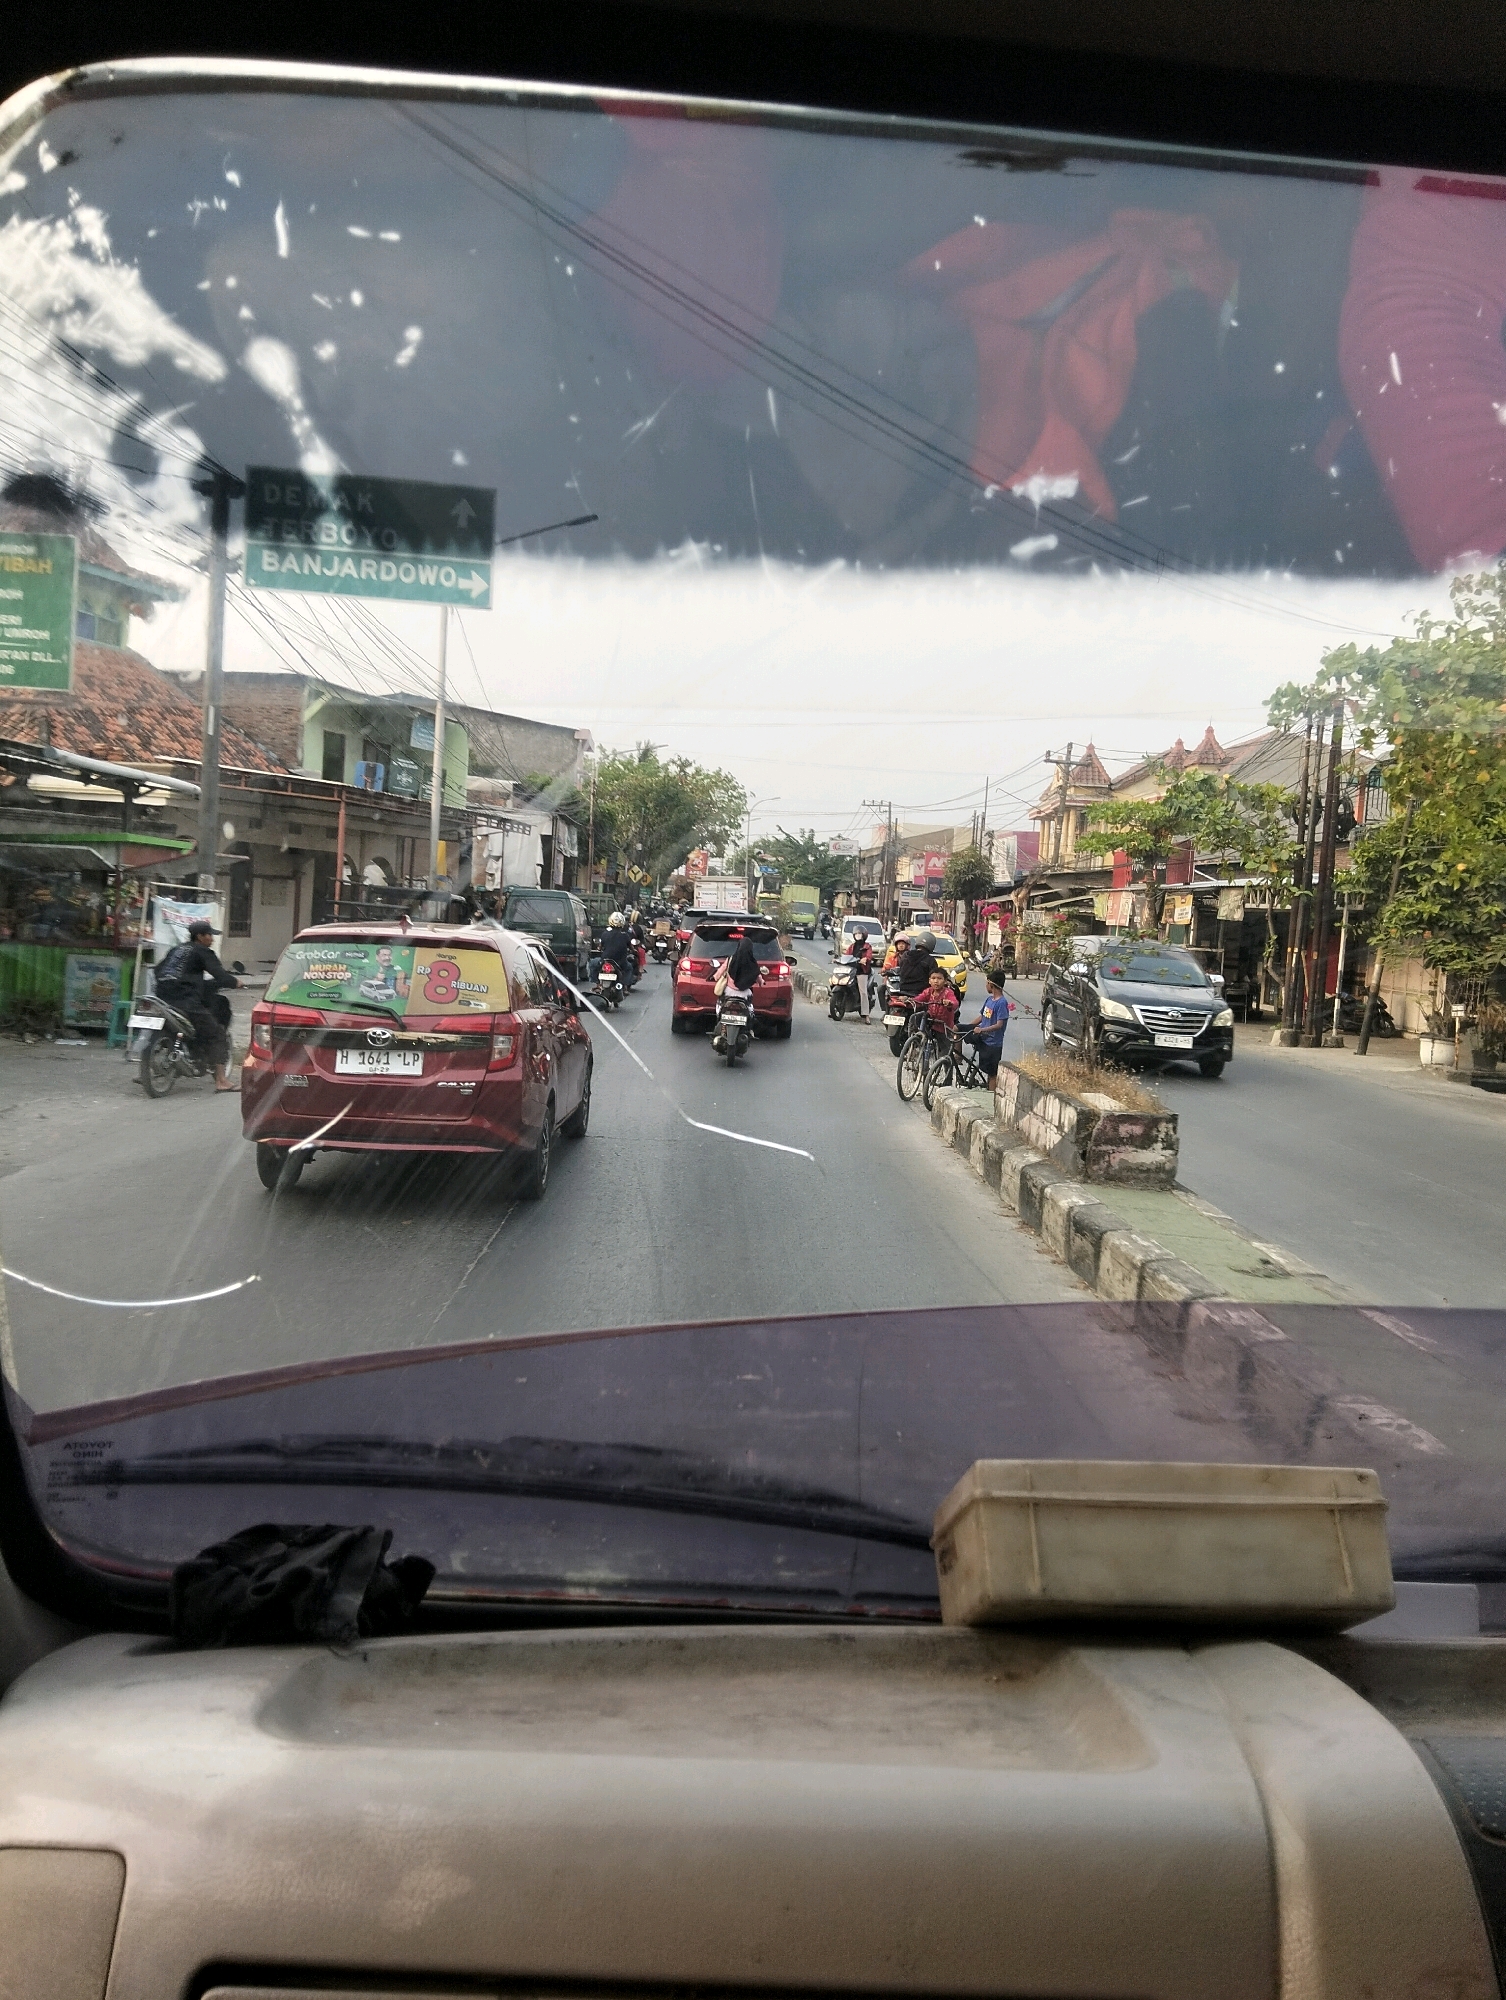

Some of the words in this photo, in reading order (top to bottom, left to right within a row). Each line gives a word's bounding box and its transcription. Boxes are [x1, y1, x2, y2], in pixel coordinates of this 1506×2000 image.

[263, 483, 374, 514] DEMAK
[261, 516, 398, 550] TERBOYO
[261, 549, 458, 588] BANJARDOWO
[295, 949, 340, 960] GrabCar
[310, 964, 347, 972] MURAH
[416, 965, 432, 976] Rp
[303, 971, 352, 981] NON-STOP
[423, 960, 461, 1005] 8
[450, 980, 489, 994] RIBUAN
[340, 1050, 349, 1065] H
[358, 1051, 391, 1066] 1641
[402, 1052, 421, 1067] LP
